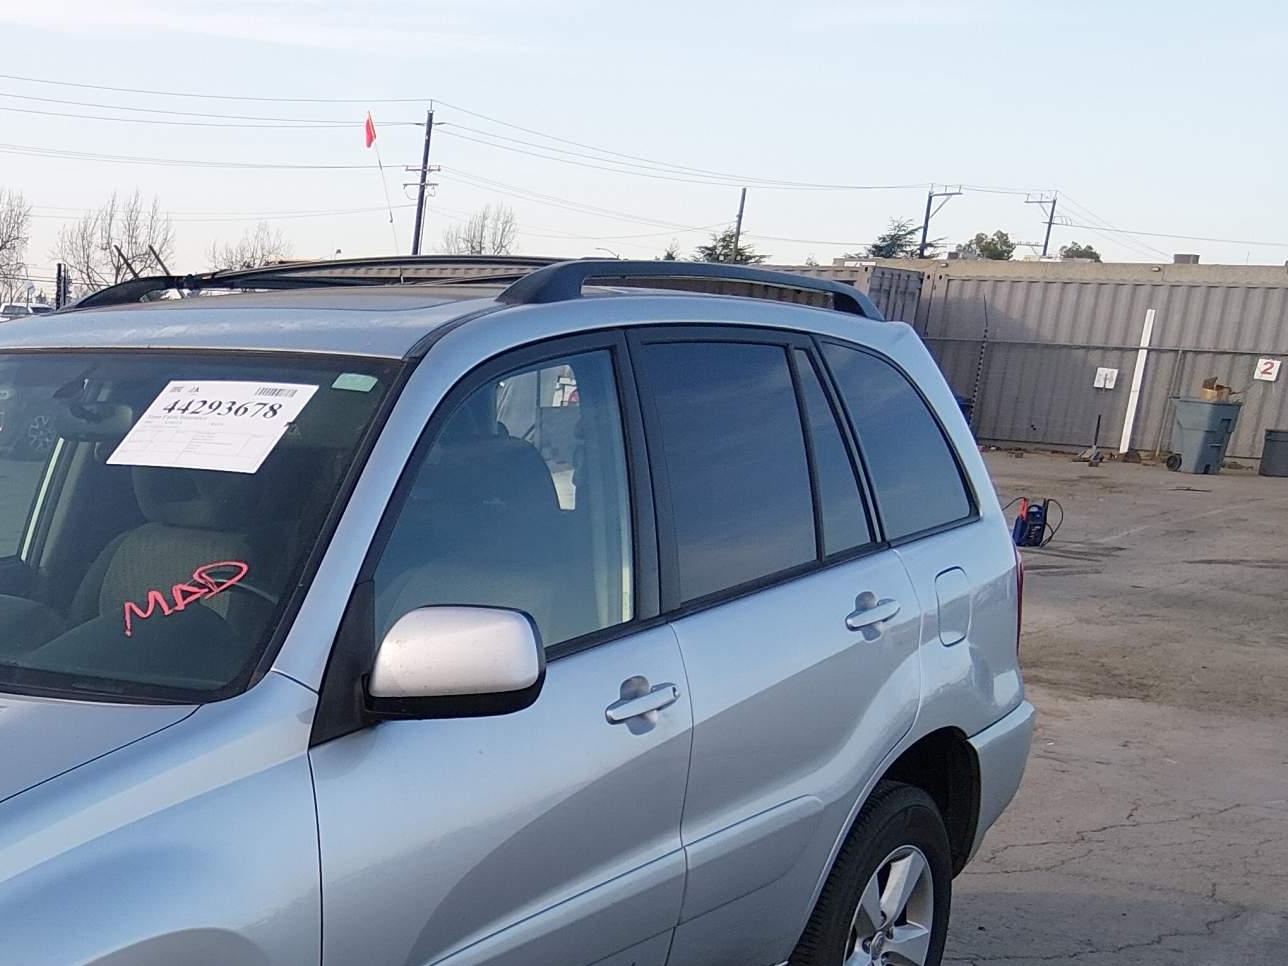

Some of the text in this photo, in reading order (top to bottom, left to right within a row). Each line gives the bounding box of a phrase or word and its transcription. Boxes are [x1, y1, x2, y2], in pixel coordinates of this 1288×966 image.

[1260, 361, 1275, 375] 2
[163, 399, 283, 419] 44293678
[124, 560, 249, 636] MAD
